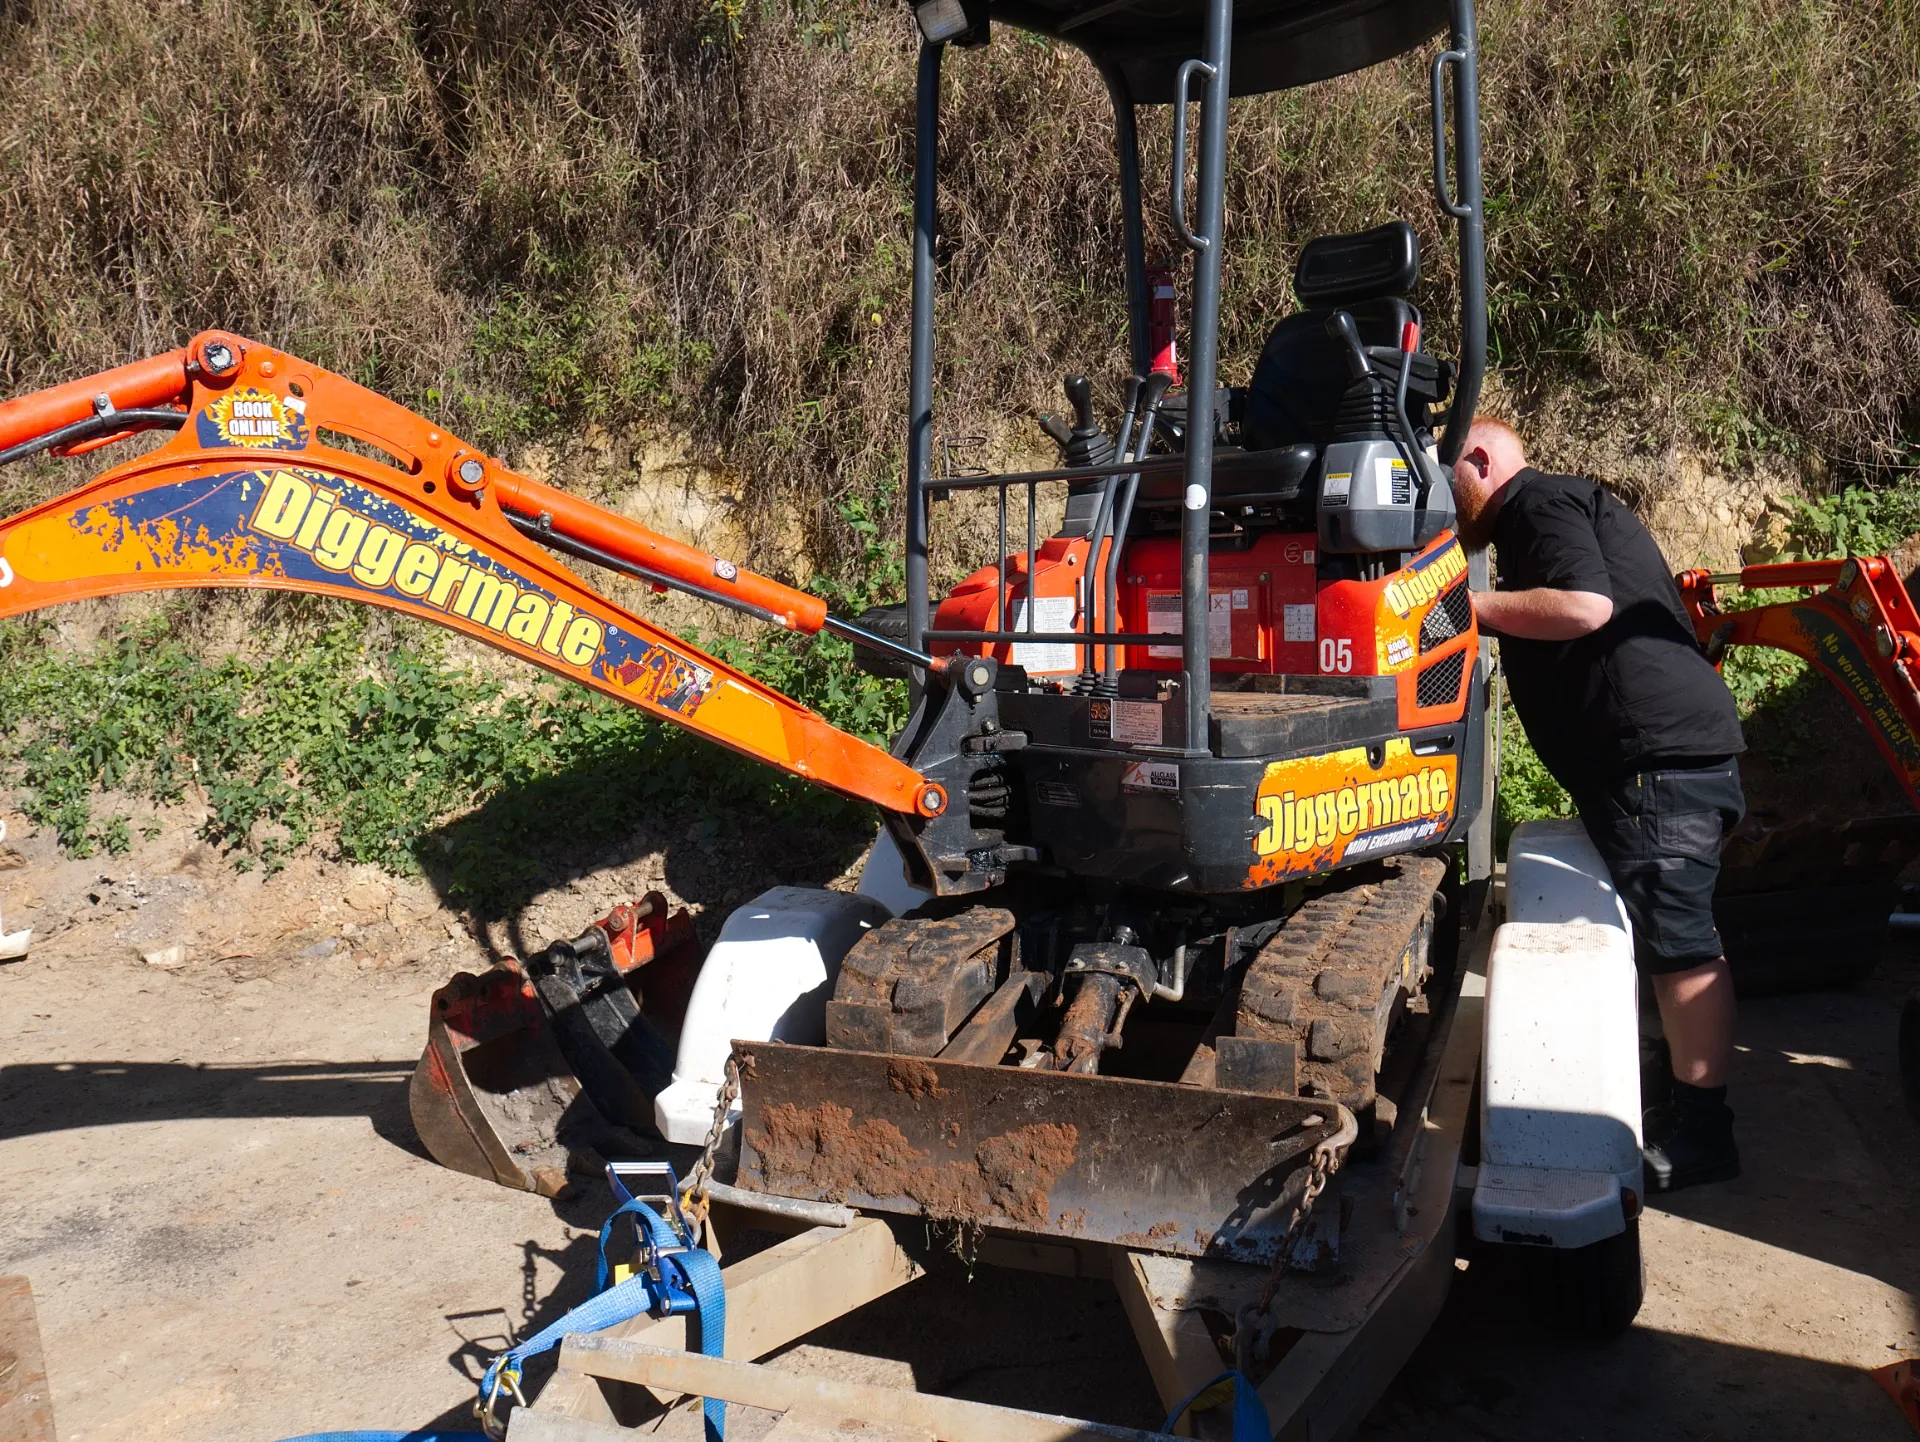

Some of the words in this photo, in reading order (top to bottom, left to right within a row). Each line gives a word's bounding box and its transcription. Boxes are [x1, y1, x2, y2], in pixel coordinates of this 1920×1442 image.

[233, 401, 273, 418] BOOK
[228, 419, 280, 436] ONLINE
[251, 469, 604, 667] Diggermate
[1383, 542, 1468, 617] Diggerma
[1320, 638, 1352, 673] 05
[1386, 637, 1408, 655] BOOK
[1388, 646, 1414, 666] ONLINE
[1822, 632, 1839, 654] No
[1837, 655, 1874, 706] worries,
[1875, 707, 1911, 745] mate!
[1257, 766, 1449, 856] Diggermate
[1344, 836, 1371, 856] Mini
[1368, 826, 1419, 851] Excavator
[1416, 821, 1439, 839] Hire
